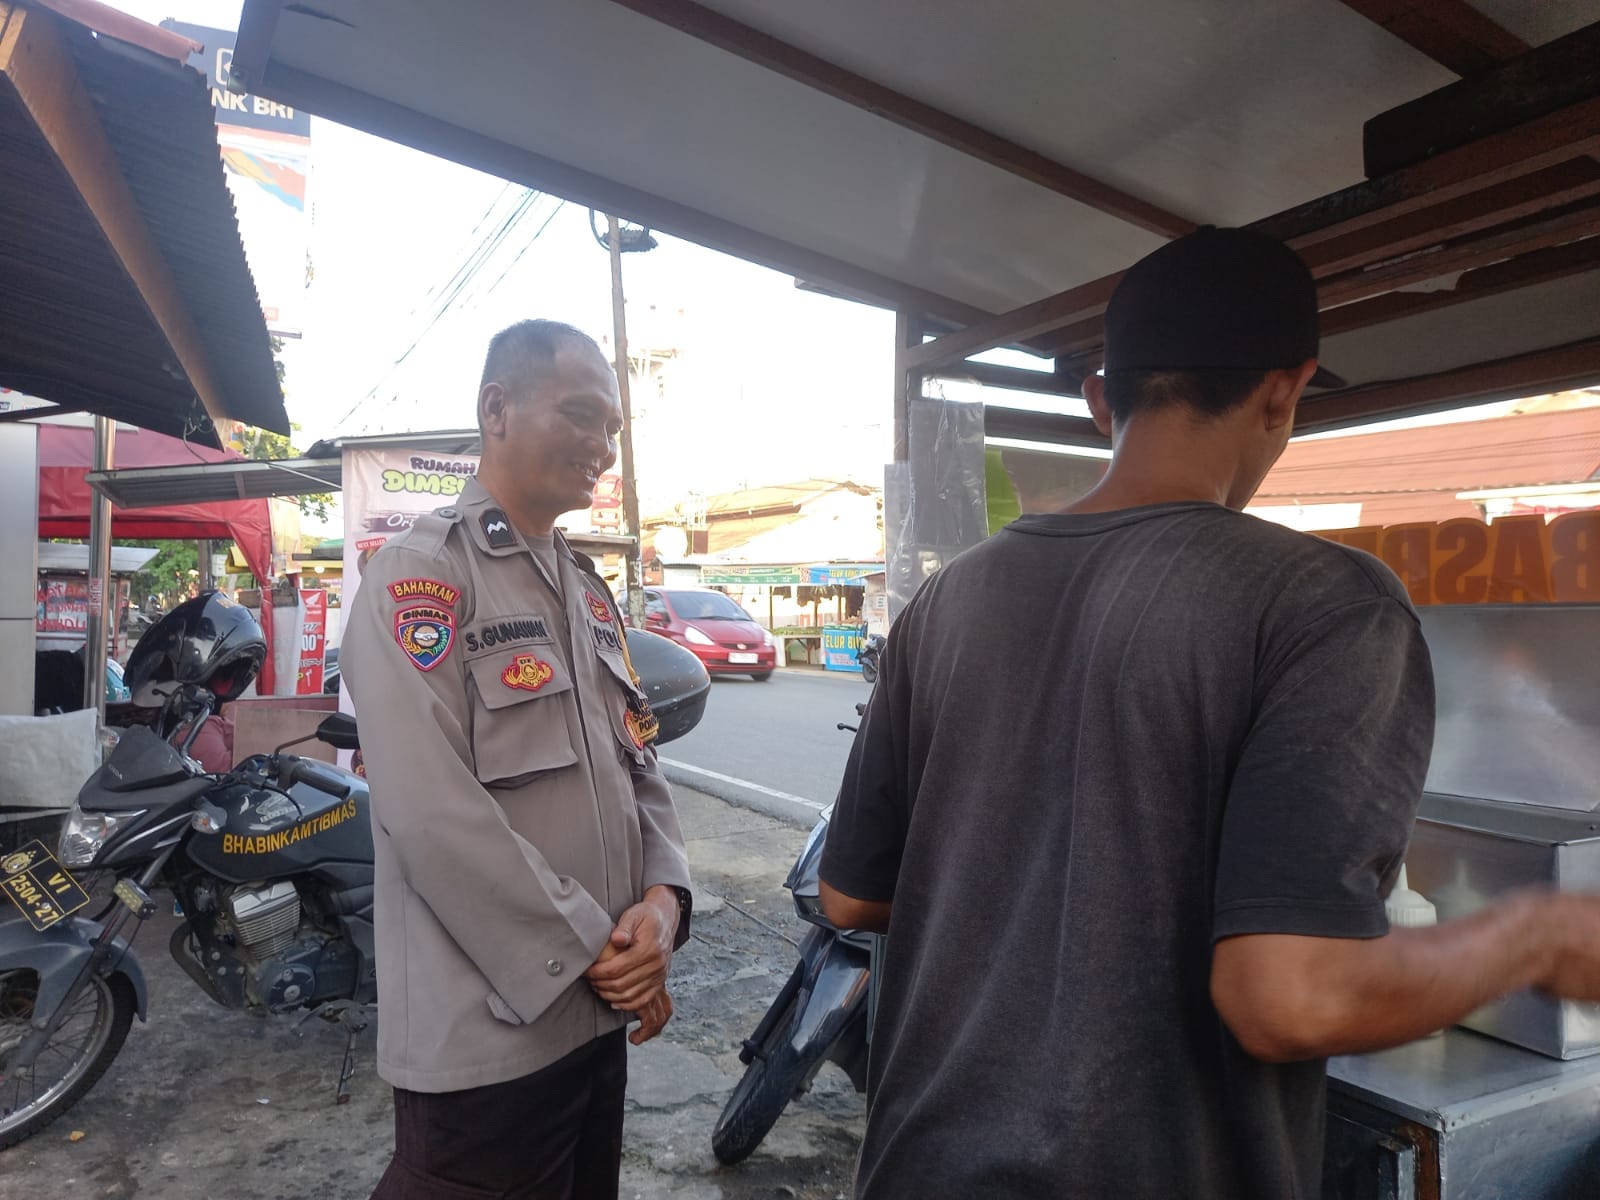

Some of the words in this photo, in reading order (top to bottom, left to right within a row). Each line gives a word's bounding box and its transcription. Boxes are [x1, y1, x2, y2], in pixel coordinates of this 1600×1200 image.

[253, 95, 294, 120] BRI
[410, 457, 476, 475] RUMAH
[394, 581, 455, 602] BAHARKAM
[402, 609, 449, 622] BINMAS
[465, 620, 549, 652] S.GUNAWAN
[223, 799, 357, 854] BHABINKAMTIBMAS
[48, 872, 71, 894] VI
[10, 874, 60, 922] 2504-27
